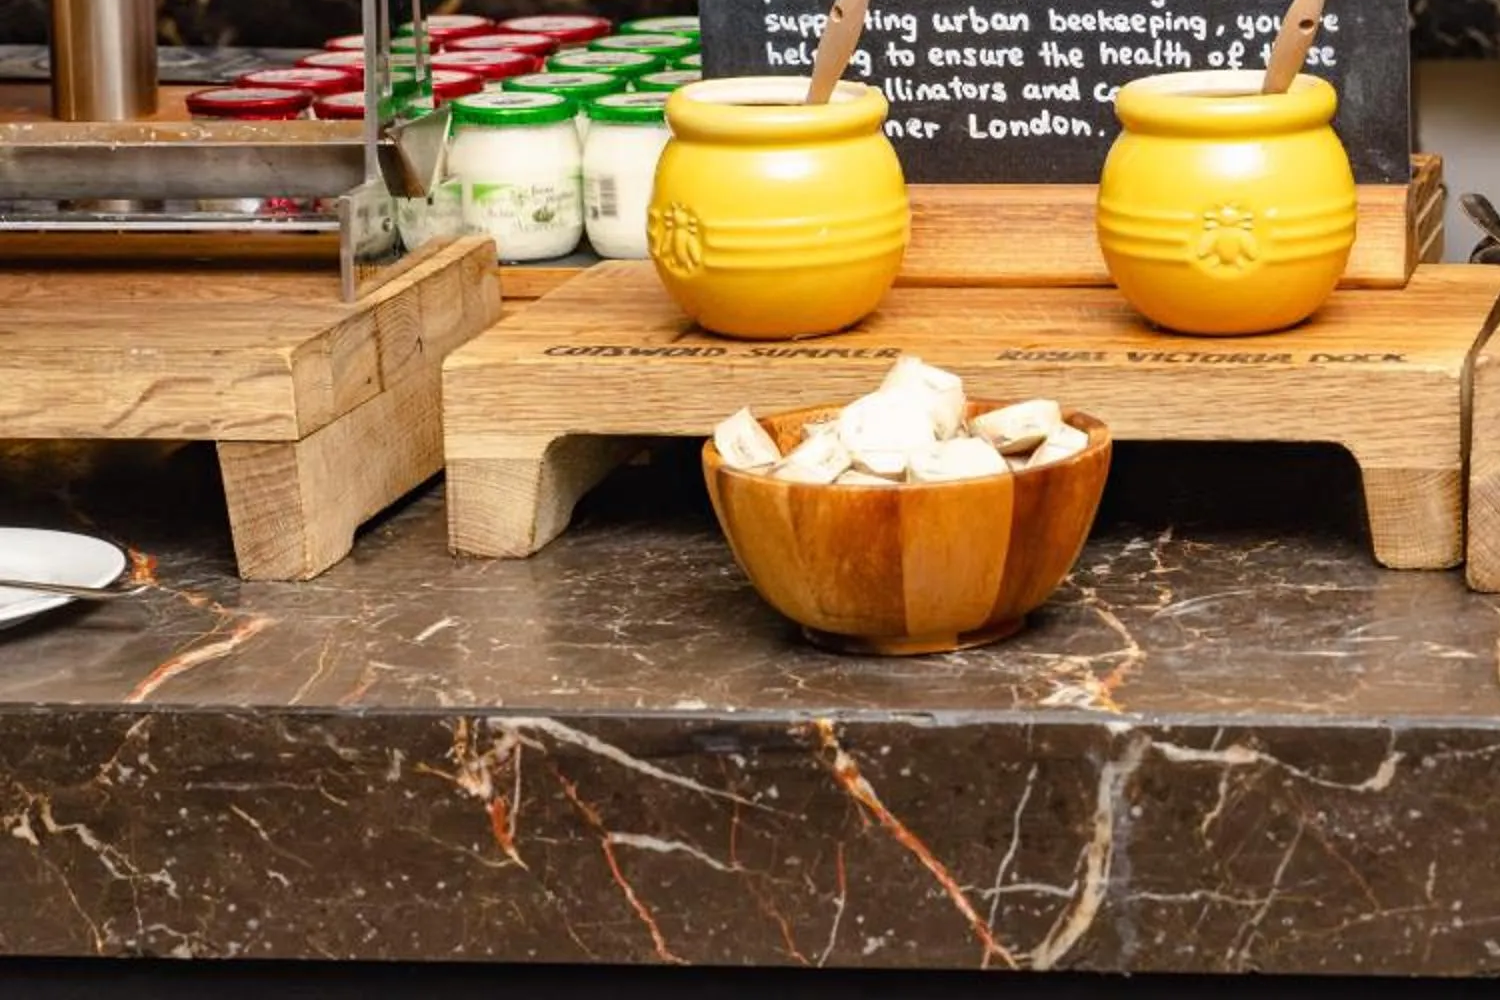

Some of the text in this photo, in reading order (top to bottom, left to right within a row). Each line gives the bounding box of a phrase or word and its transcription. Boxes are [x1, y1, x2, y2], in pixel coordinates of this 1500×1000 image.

[764, 8, 918, 43] suppting
[931, 5, 1030, 35] urban
[765, 37, 1337, 77] helg to ensure the health of tse
[1022, 76, 1081, 102] and
[544, 345, 903, 359] COTSWOLD SUMMER
[1126, 351, 1293, 364] VICTORIA
[1308, 353, 1408, 363] DOCK
